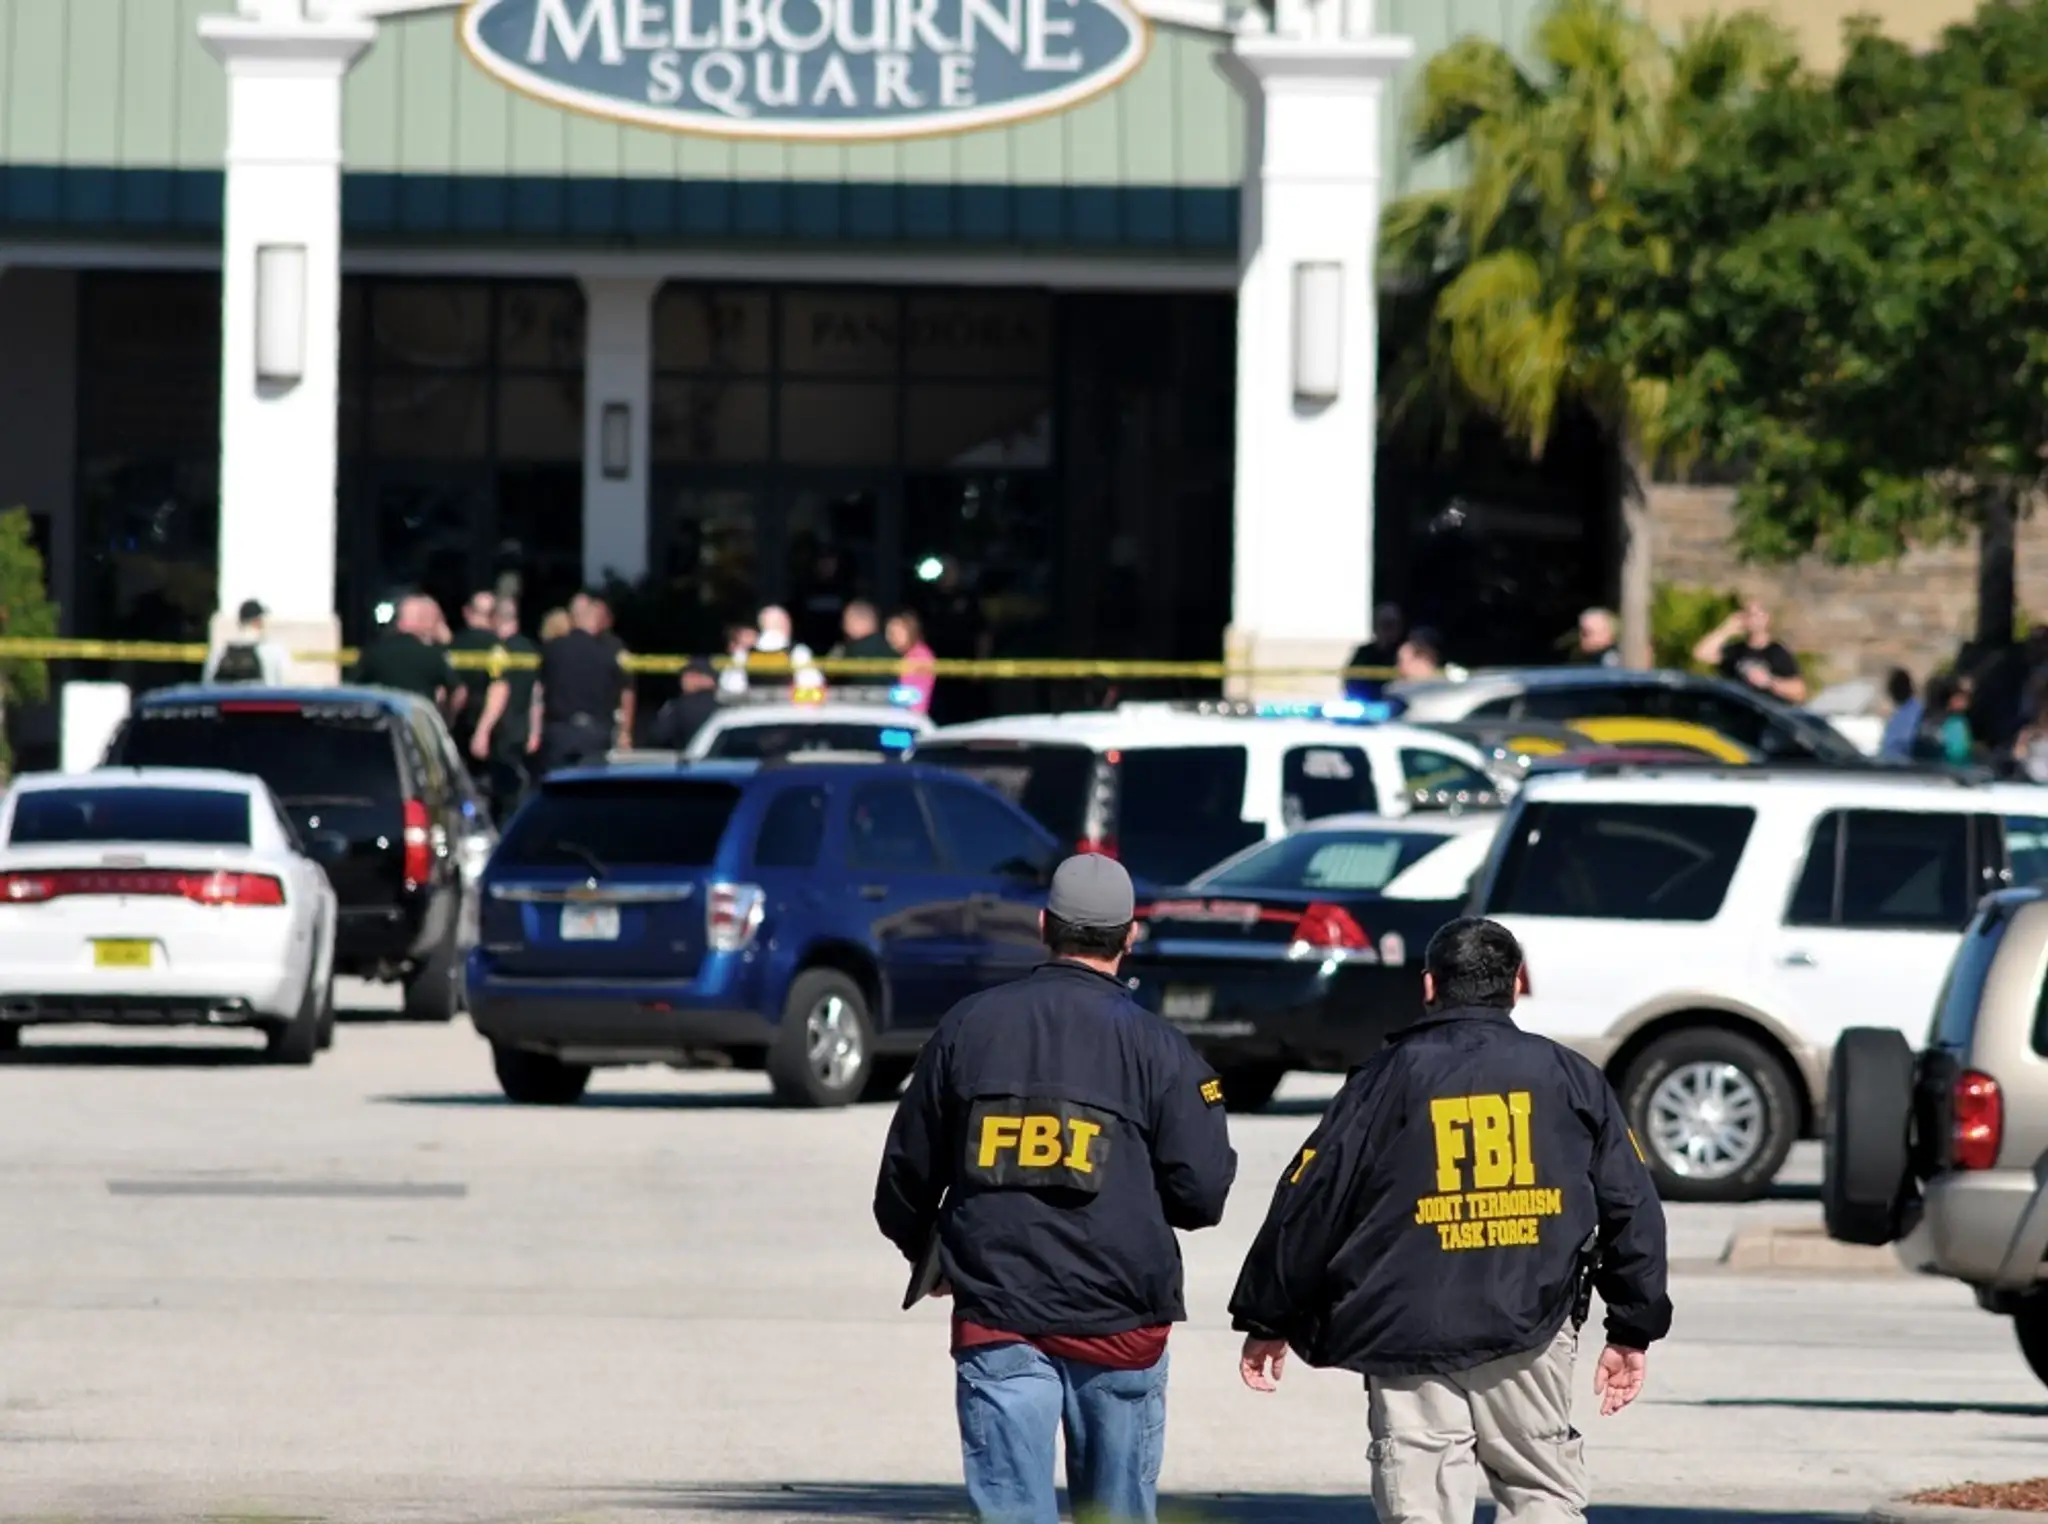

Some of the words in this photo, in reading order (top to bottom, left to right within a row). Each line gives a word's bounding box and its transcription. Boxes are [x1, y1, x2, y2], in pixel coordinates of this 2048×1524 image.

[526, 0, 1083, 71] MELBOURNE
[646, 49, 977, 117] SQUARE
[1200, 1079, 1223, 1103] FBI
[977, 1115, 1102, 1173] FBI
[1430, 1091, 1535, 1192] FBI
[1415, 1194, 1463, 1225] JOINT
[1465, 1188, 1563, 1219] TERRORISM
[1437, 1221, 1486, 1250] TASK
[1486, 1217, 1540, 1247] FORCE
